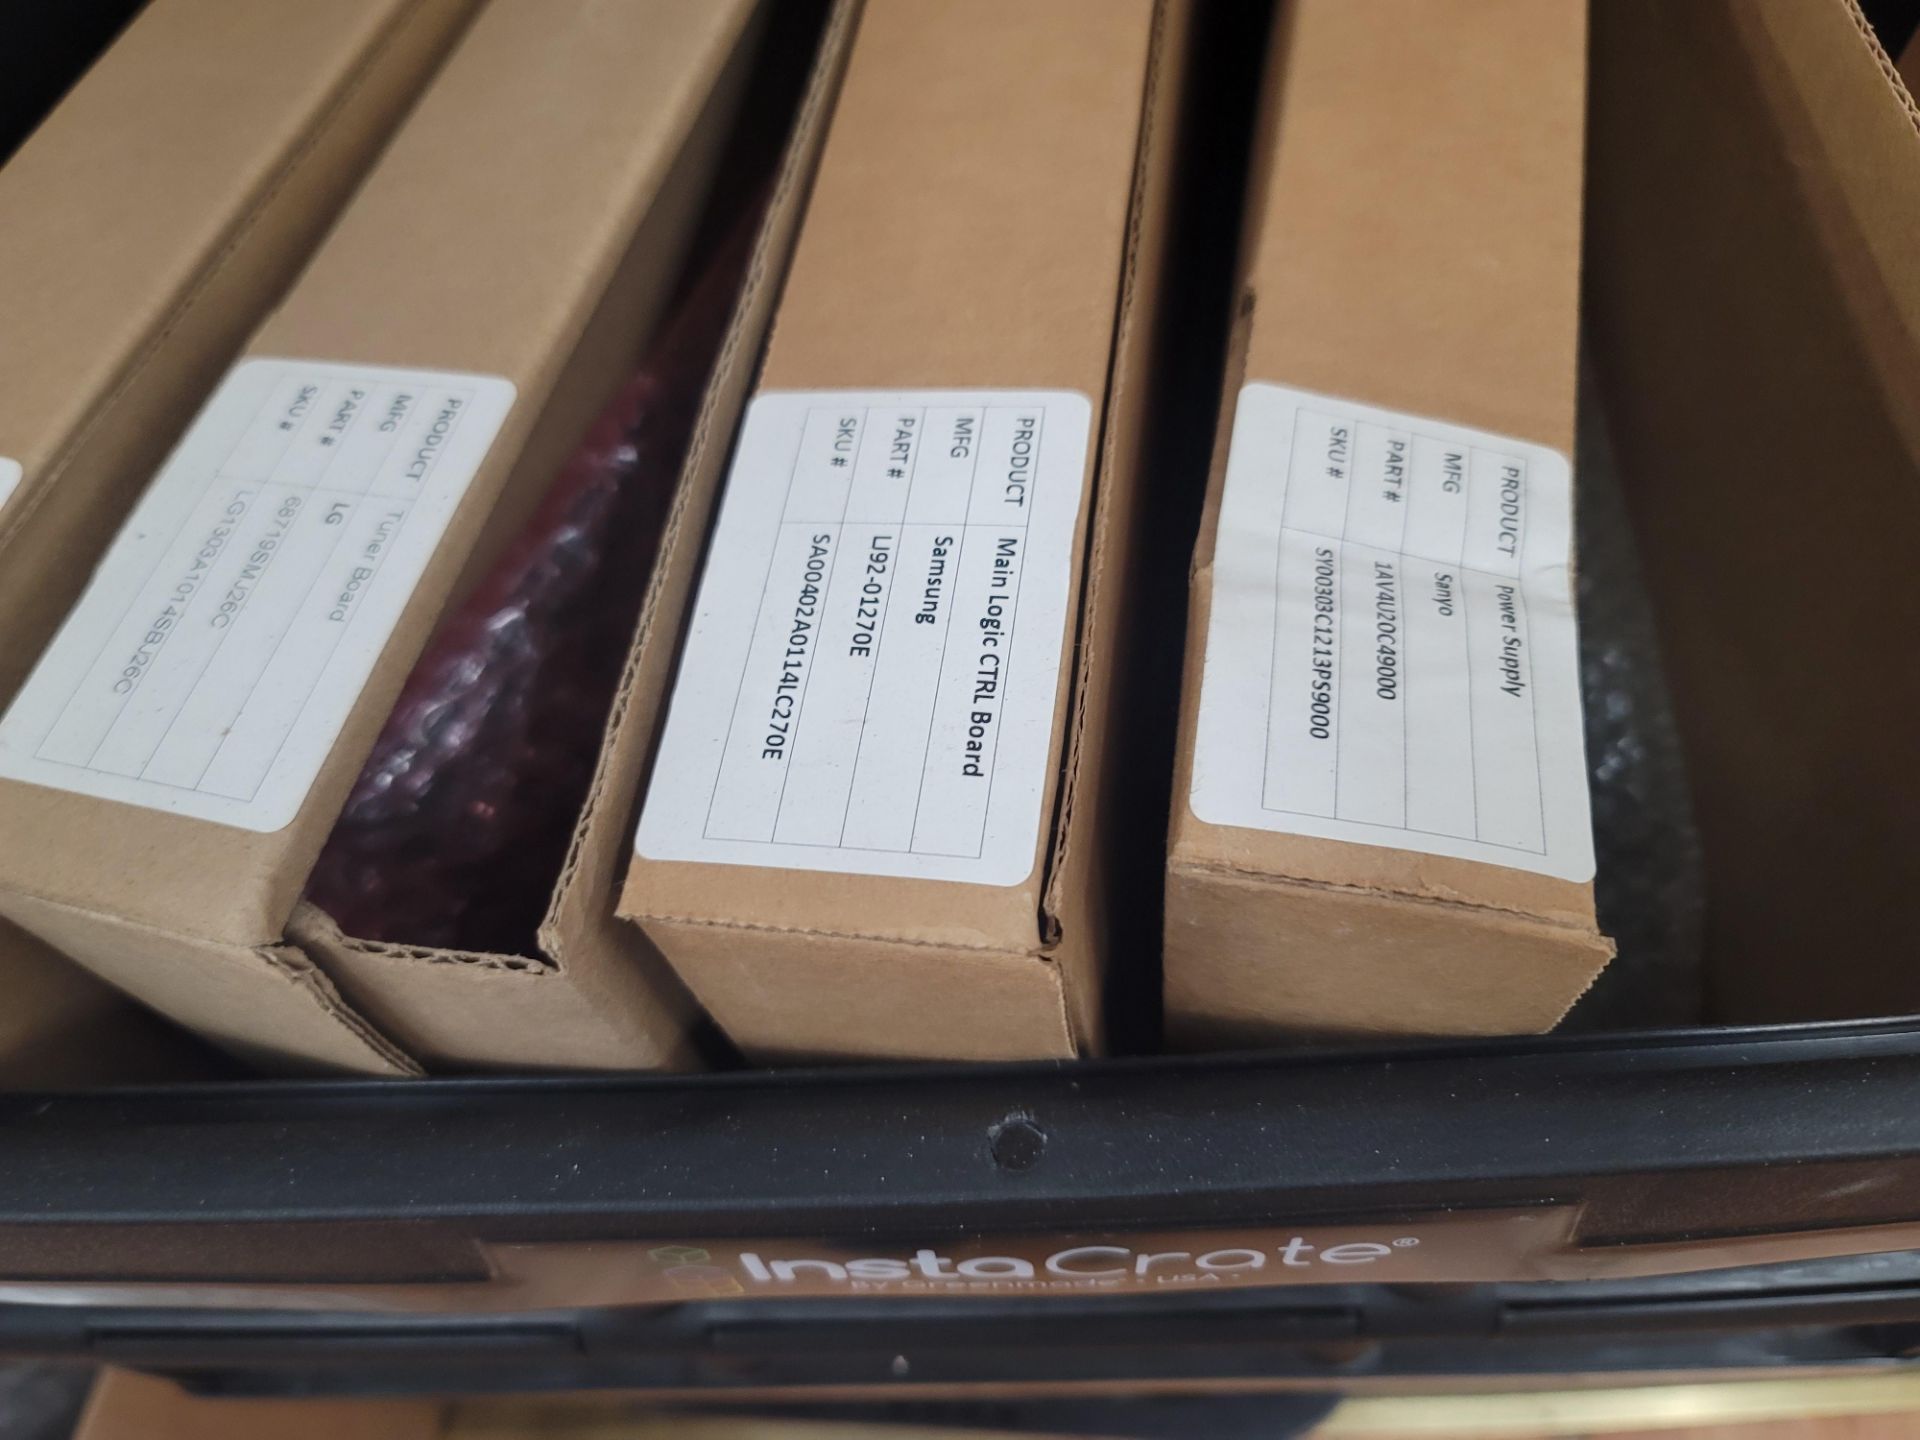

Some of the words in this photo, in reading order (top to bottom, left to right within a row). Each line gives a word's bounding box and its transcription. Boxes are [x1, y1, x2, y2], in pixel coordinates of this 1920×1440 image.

[288, 386, 318, 418] SKU
[328, 390, 364, 432] PART
[379, 394, 412, 432] MFG
[406, 398, 462, 482] PRODUCT
[832, 417, 858, 452] SKU
[888, 418, 916, 464] PART
[949, 417, 975, 459] MFG
[1327, 426, 1348, 464] SKU
[829, 456, 849, 468] #
[886, 467, 905, 479] #
[1003, 417, 1035, 507] PRODUCT
[1325, 466, 1344, 479] #
[1385, 439, 1406, 488] PART
[1442, 451, 1463, 495] MFG
[324, 502, 350, 526] LG
[1382, 490, 1401, 504] #
[1497, 465, 1520, 559] PRODUCT
[366, 510, 404, 563] Tuner
[915, 536, 954, 625] Samsung
[990, 537, 1018, 588] Main
[328, 566, 373, 623] Board
[849, 535, 893, 659] LJ92-01270E
[1431, 571, 1454, 617] Sanyo
[1496, 584, 1516, 633] Power
[979, 594, 1010, 648] Logic
[1309, 547, 1335, 740] SY00303C1213PS9000
[761, 533, 831, 761] SA00402A0114LC270E
[1497, 635, 1527, 698] Supply
[972, 653, 1001, 705] CTRL
[961, 710, 993, 778] Board
